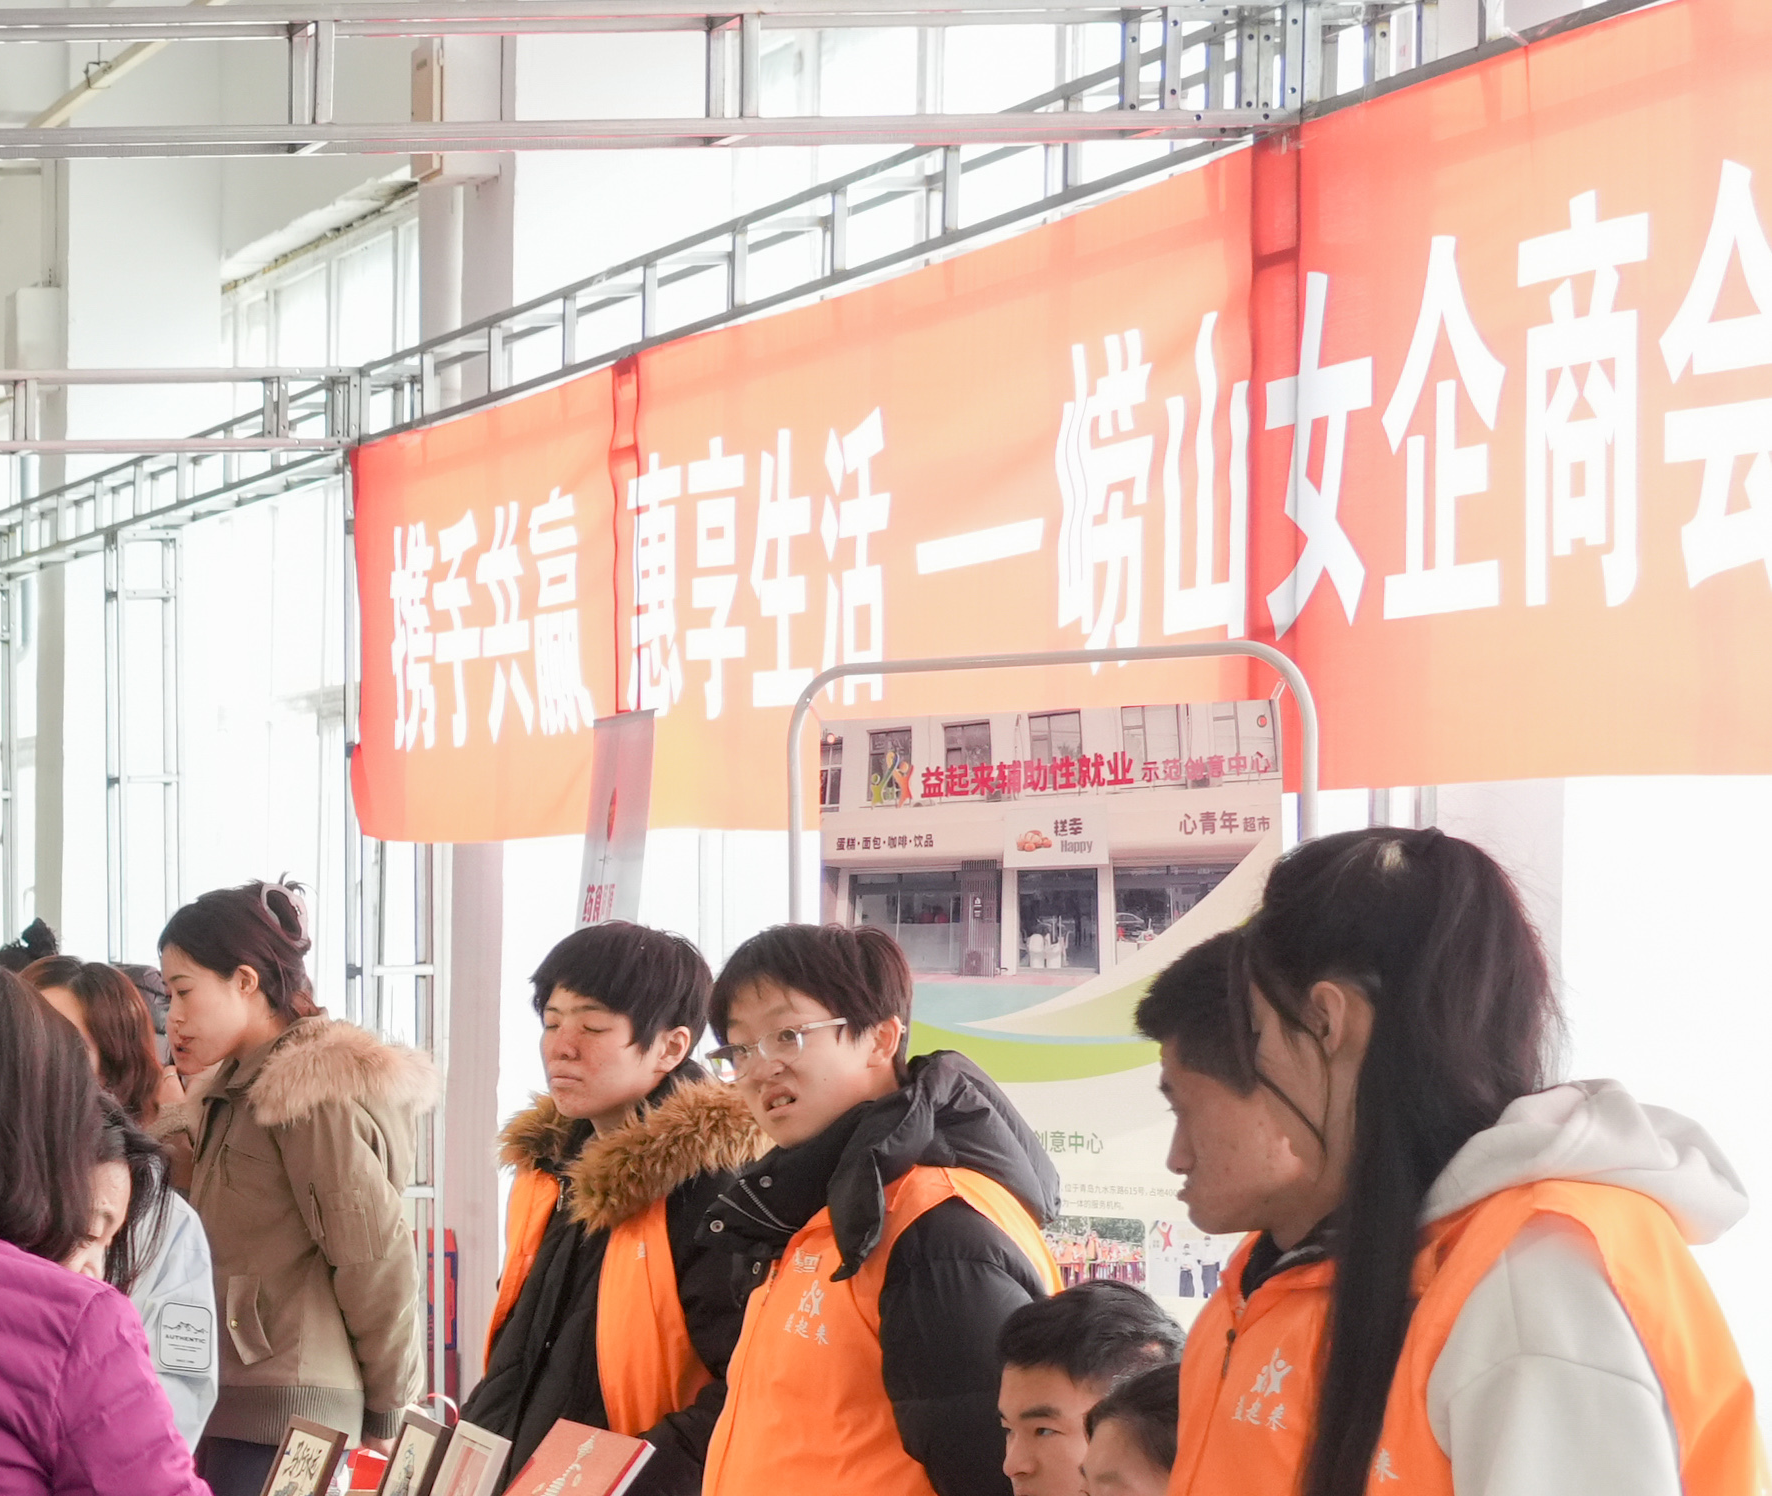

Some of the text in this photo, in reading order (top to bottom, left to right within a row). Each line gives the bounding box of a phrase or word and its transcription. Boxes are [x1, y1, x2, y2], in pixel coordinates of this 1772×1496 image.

[391, 486, 596, 750] 携手共赢
[921, 751, 1272, 798] 益起来辅助性就业 示范创意中心
[1179, 811, 1271, 835] 心青年 超市
[1060, 840, 1093, 854] Happy
[165, 1333, 206, 1345] AUTHENTIC
